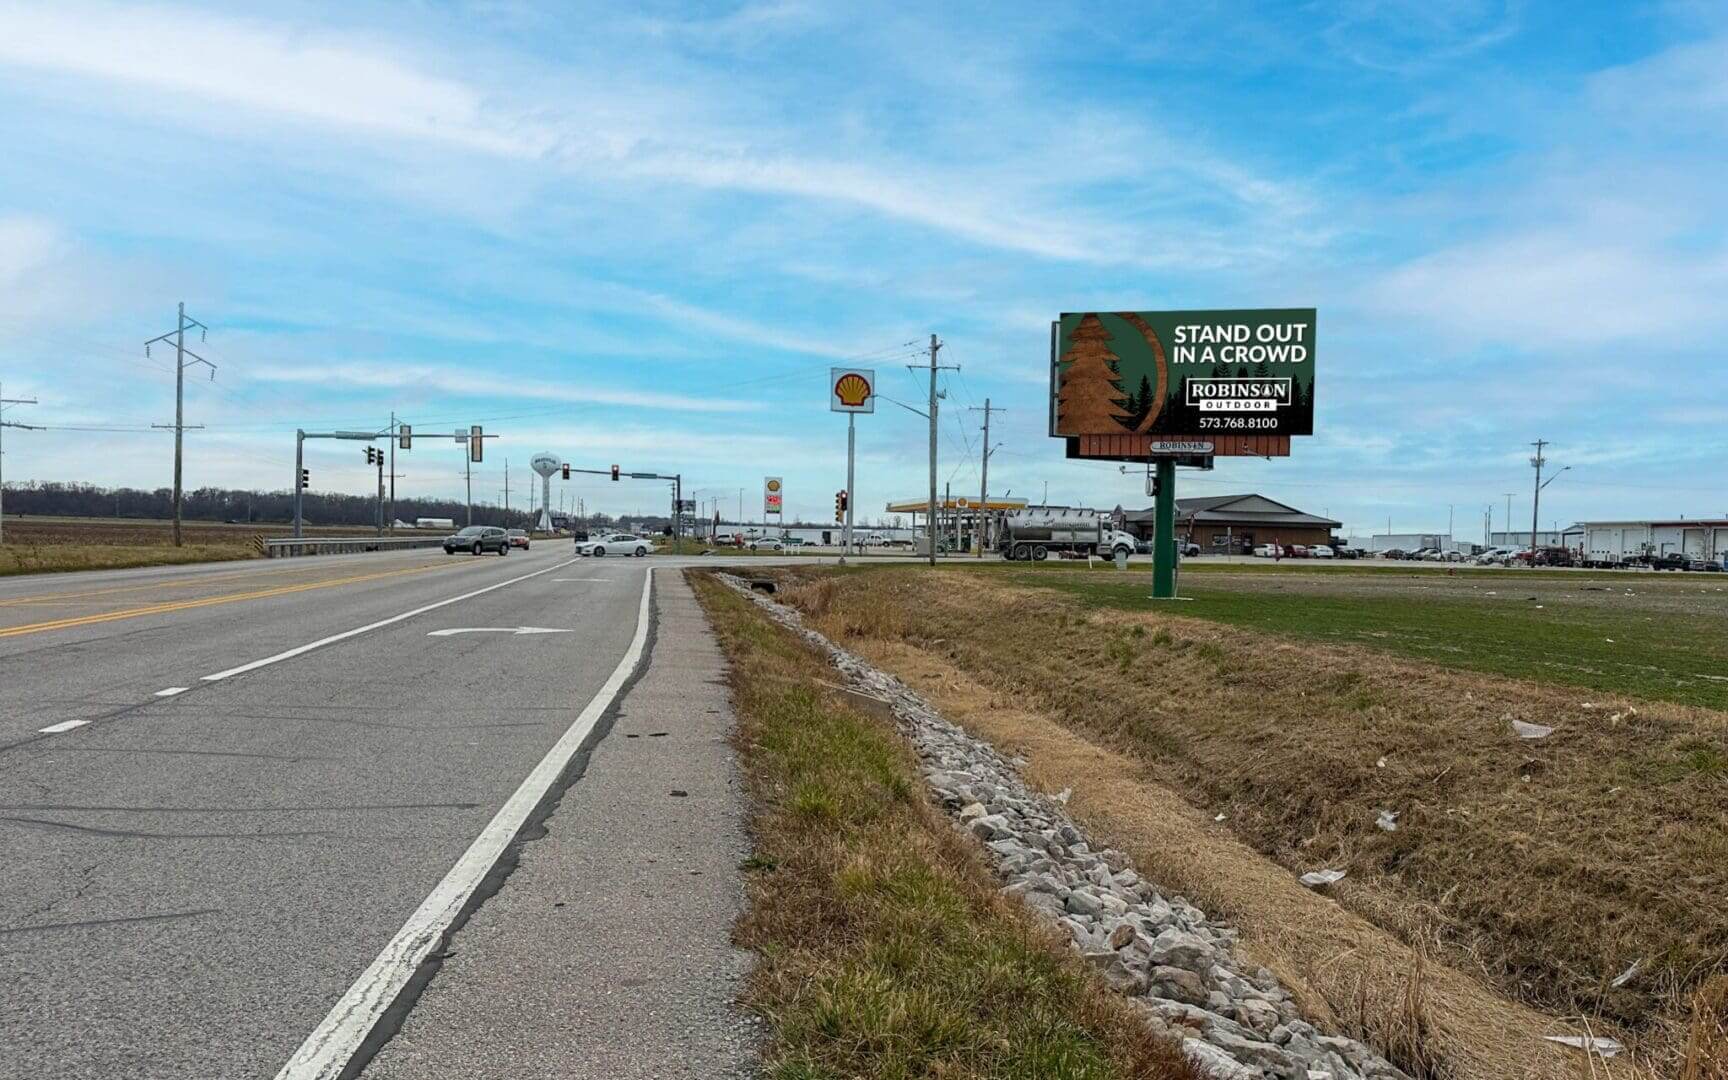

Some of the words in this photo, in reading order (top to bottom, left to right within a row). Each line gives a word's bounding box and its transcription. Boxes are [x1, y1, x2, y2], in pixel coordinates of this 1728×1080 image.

[1174, 324, 1250, 343] STAND
[1256, 323, 1307, 343] OUT
[1173, 346, 1196, 364] IN
[1200, 346, 1216, 363] A
[1220, 345, 1307, 363] CROWD
[1191, 383, 1287, 398] ROBINSON
[1206, 401, 1271, 409] OUTDOOR
[1199, 417, 1278, 429] 573.768.8100
